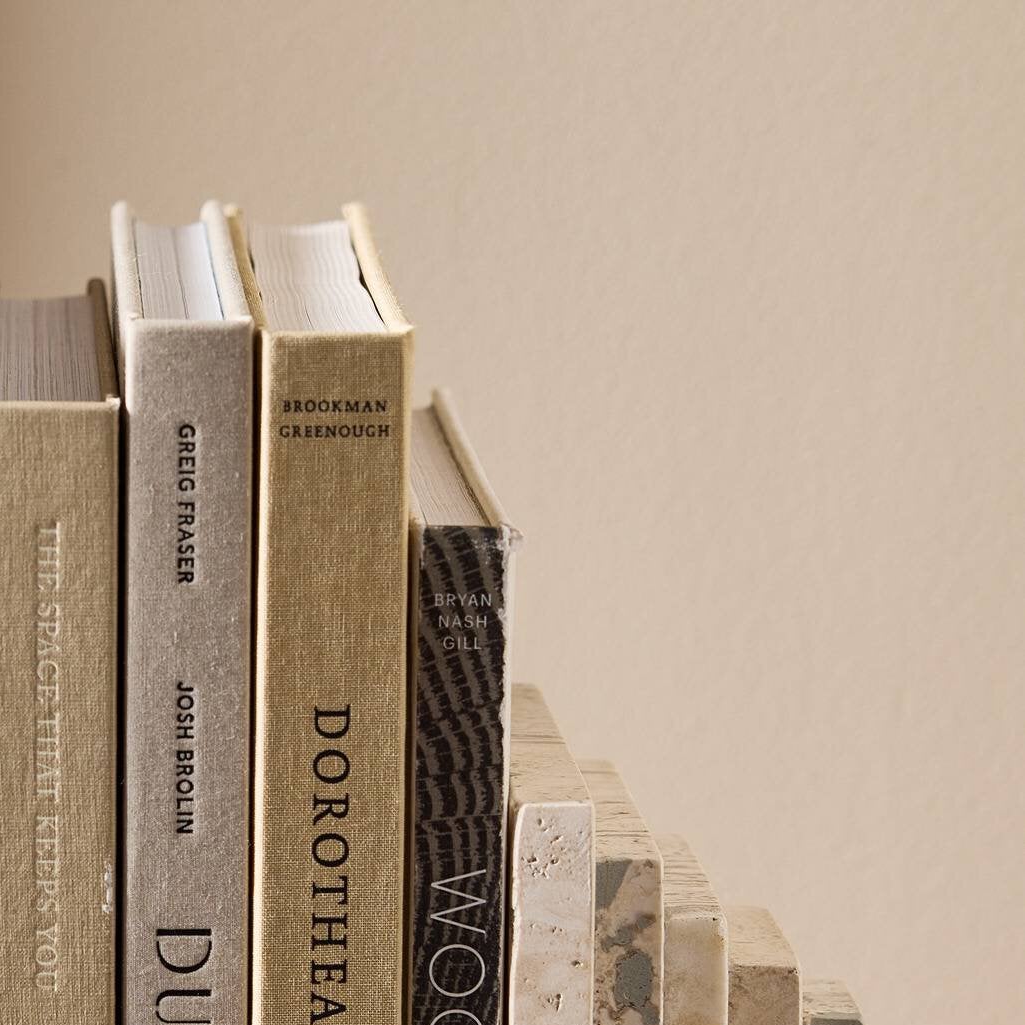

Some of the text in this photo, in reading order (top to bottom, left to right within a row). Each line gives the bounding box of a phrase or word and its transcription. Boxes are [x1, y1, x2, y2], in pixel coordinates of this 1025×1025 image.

[283, 400, 387, 413] BROOKMAN
[279, 424, 391, 438] GREENOUGH
[177, 424, 196, 585] GREIG FRASER
[434, 593, 492, 607] BRYAN
[438, 615, 487, 628] NASH
[443, 636, 482, 650] GILL
[36, 521, 61, 992] THE SPACE THAT KEEPS YOU
[176, 682, 194, 834] JOSH BROLIN
[310, 705, 350, 1025] DOROTHEA
